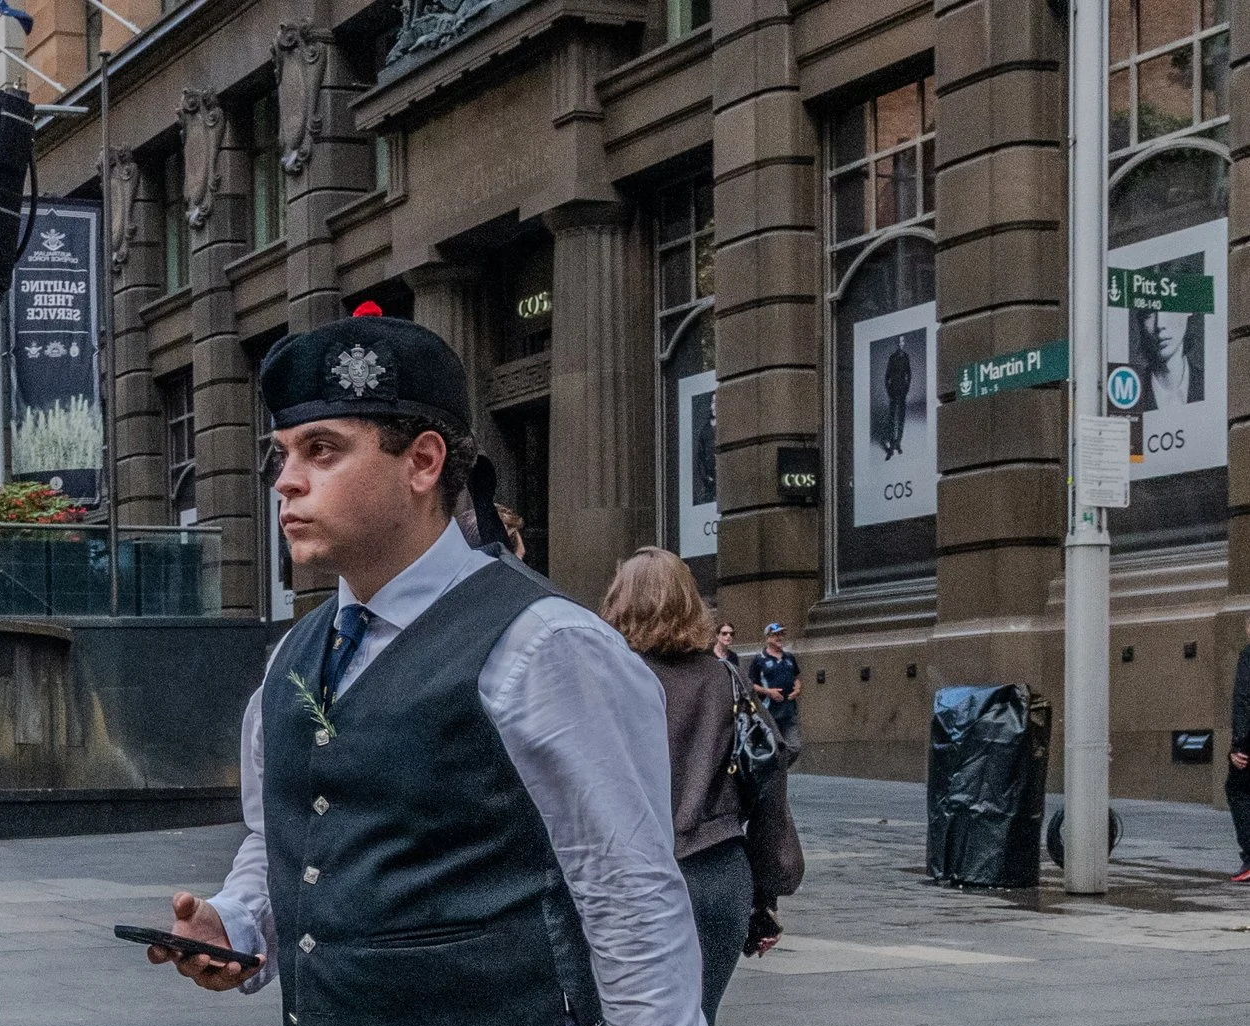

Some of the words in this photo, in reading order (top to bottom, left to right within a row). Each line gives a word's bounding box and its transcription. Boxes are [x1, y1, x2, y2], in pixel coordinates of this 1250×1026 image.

[1133, 274, 1157, 295] Pitt
[1160, 277, 1178, 296] St
[518, 291, 548, 318] COS
[980, 355, 1024, 382] Martin
[1027, 350, 1041, 371] Pl
[1114, 375, 1134, 400] M
[1147, 429, 1185, 454] COS
[783, 473, 816, 487] COS
[883, 480, 913, 501] COS
